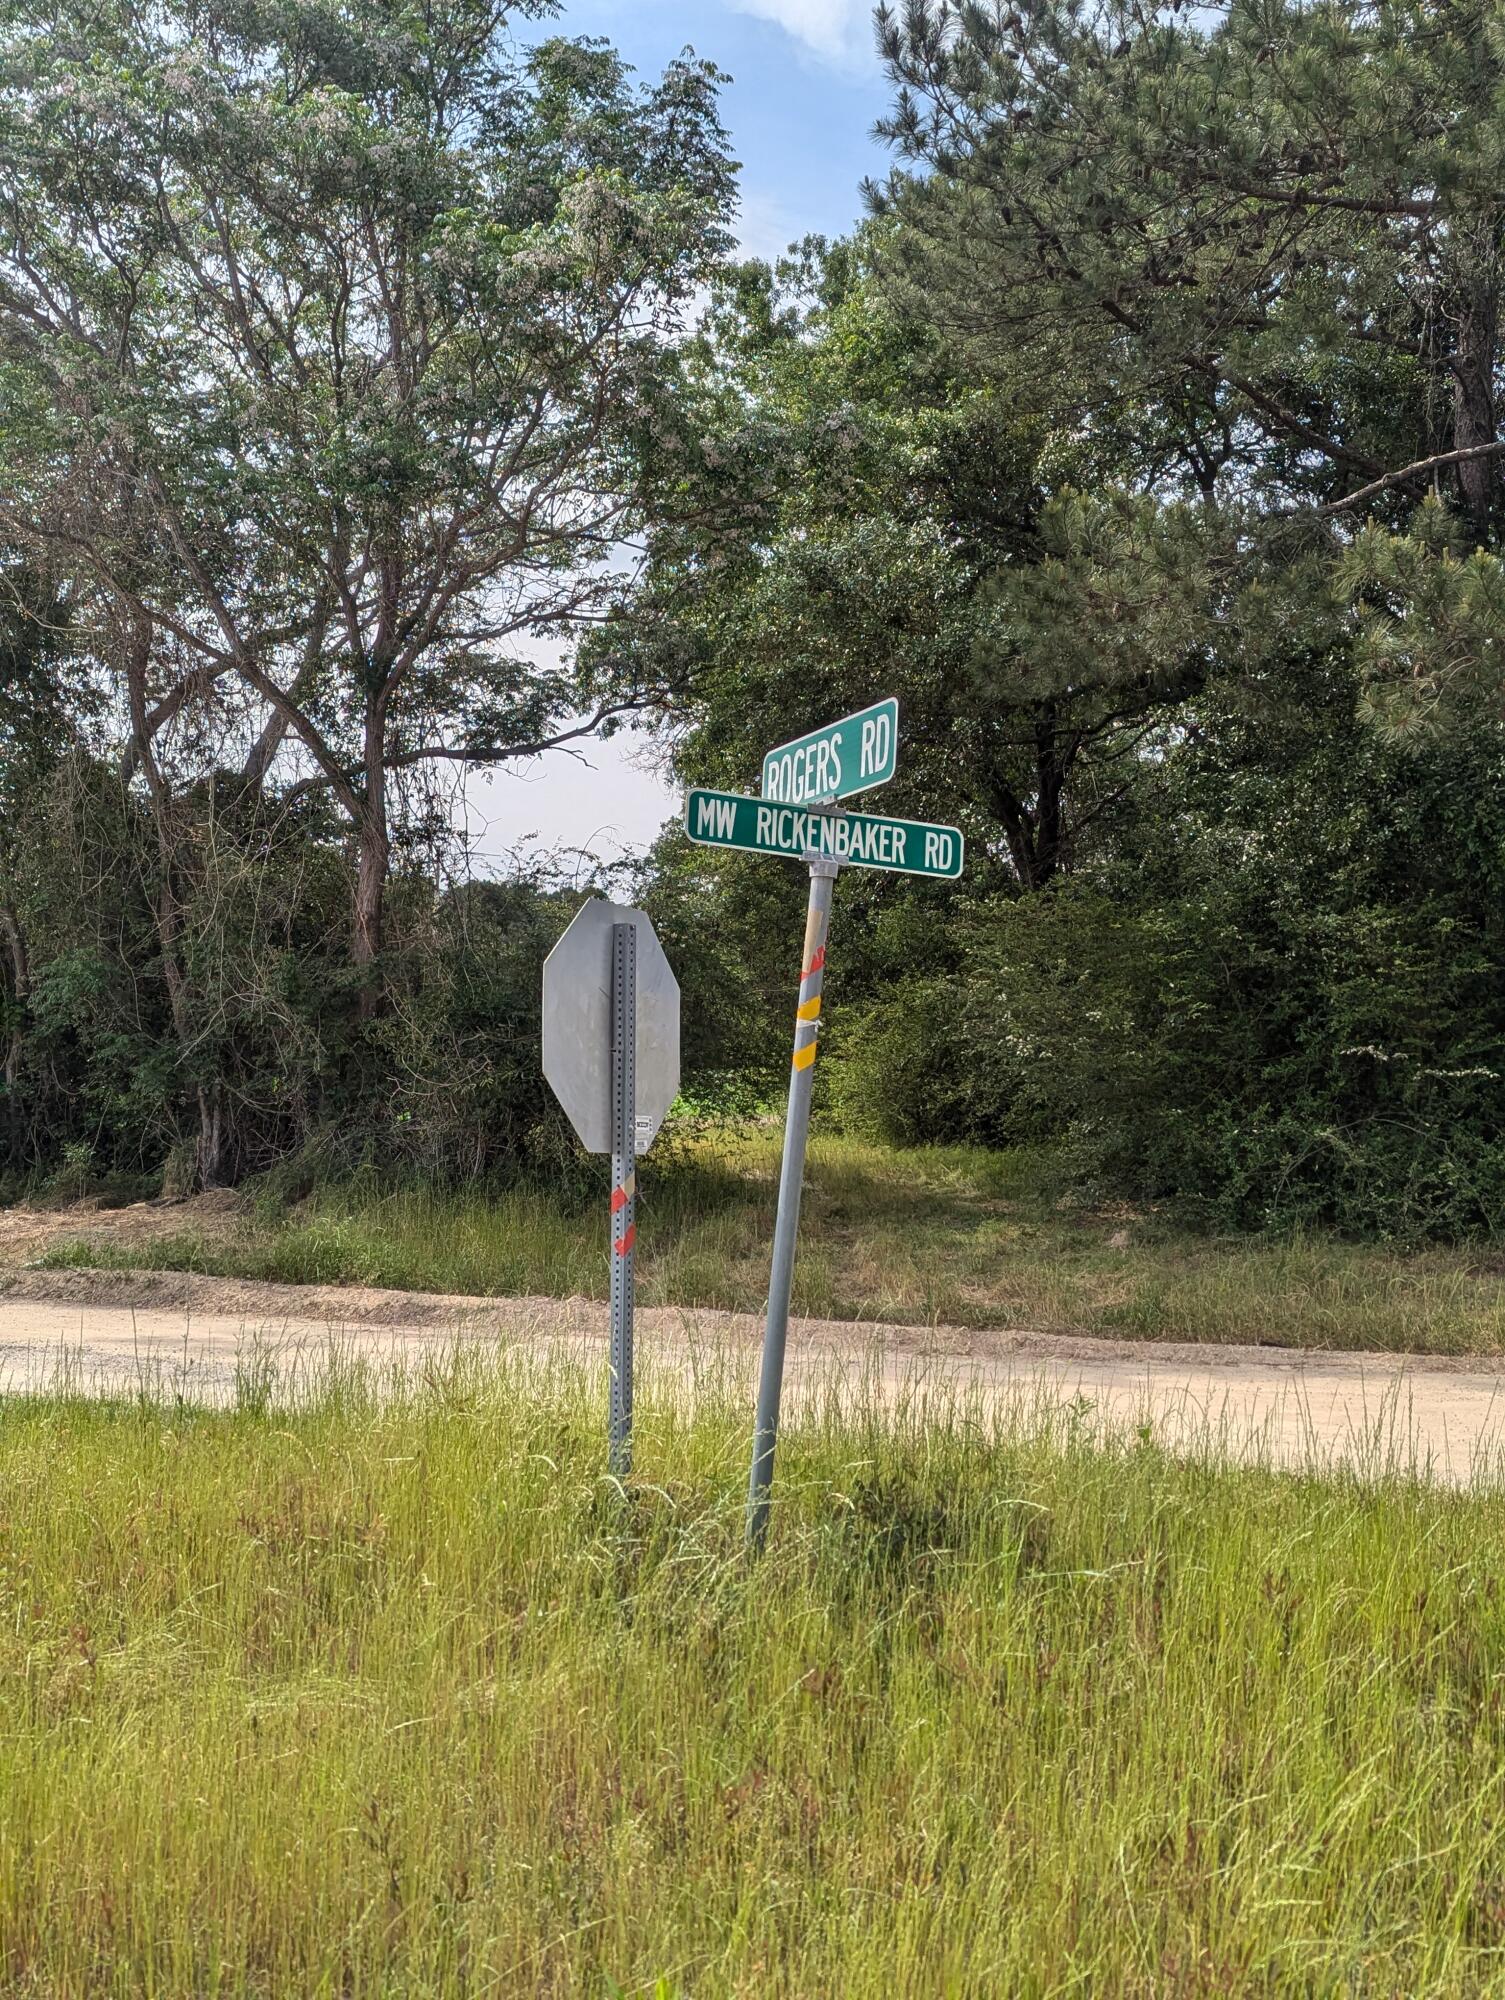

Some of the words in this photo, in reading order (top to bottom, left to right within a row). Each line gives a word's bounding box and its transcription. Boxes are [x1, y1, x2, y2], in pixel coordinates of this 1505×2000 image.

[767, 732, 842, 803] ROGERS
[860, 714, 890, 778] RD
[697, 797, 737, 839] MW
[756, 806, 907, 865] RICKENBAKER
[925, 831, 953, 871] RD
